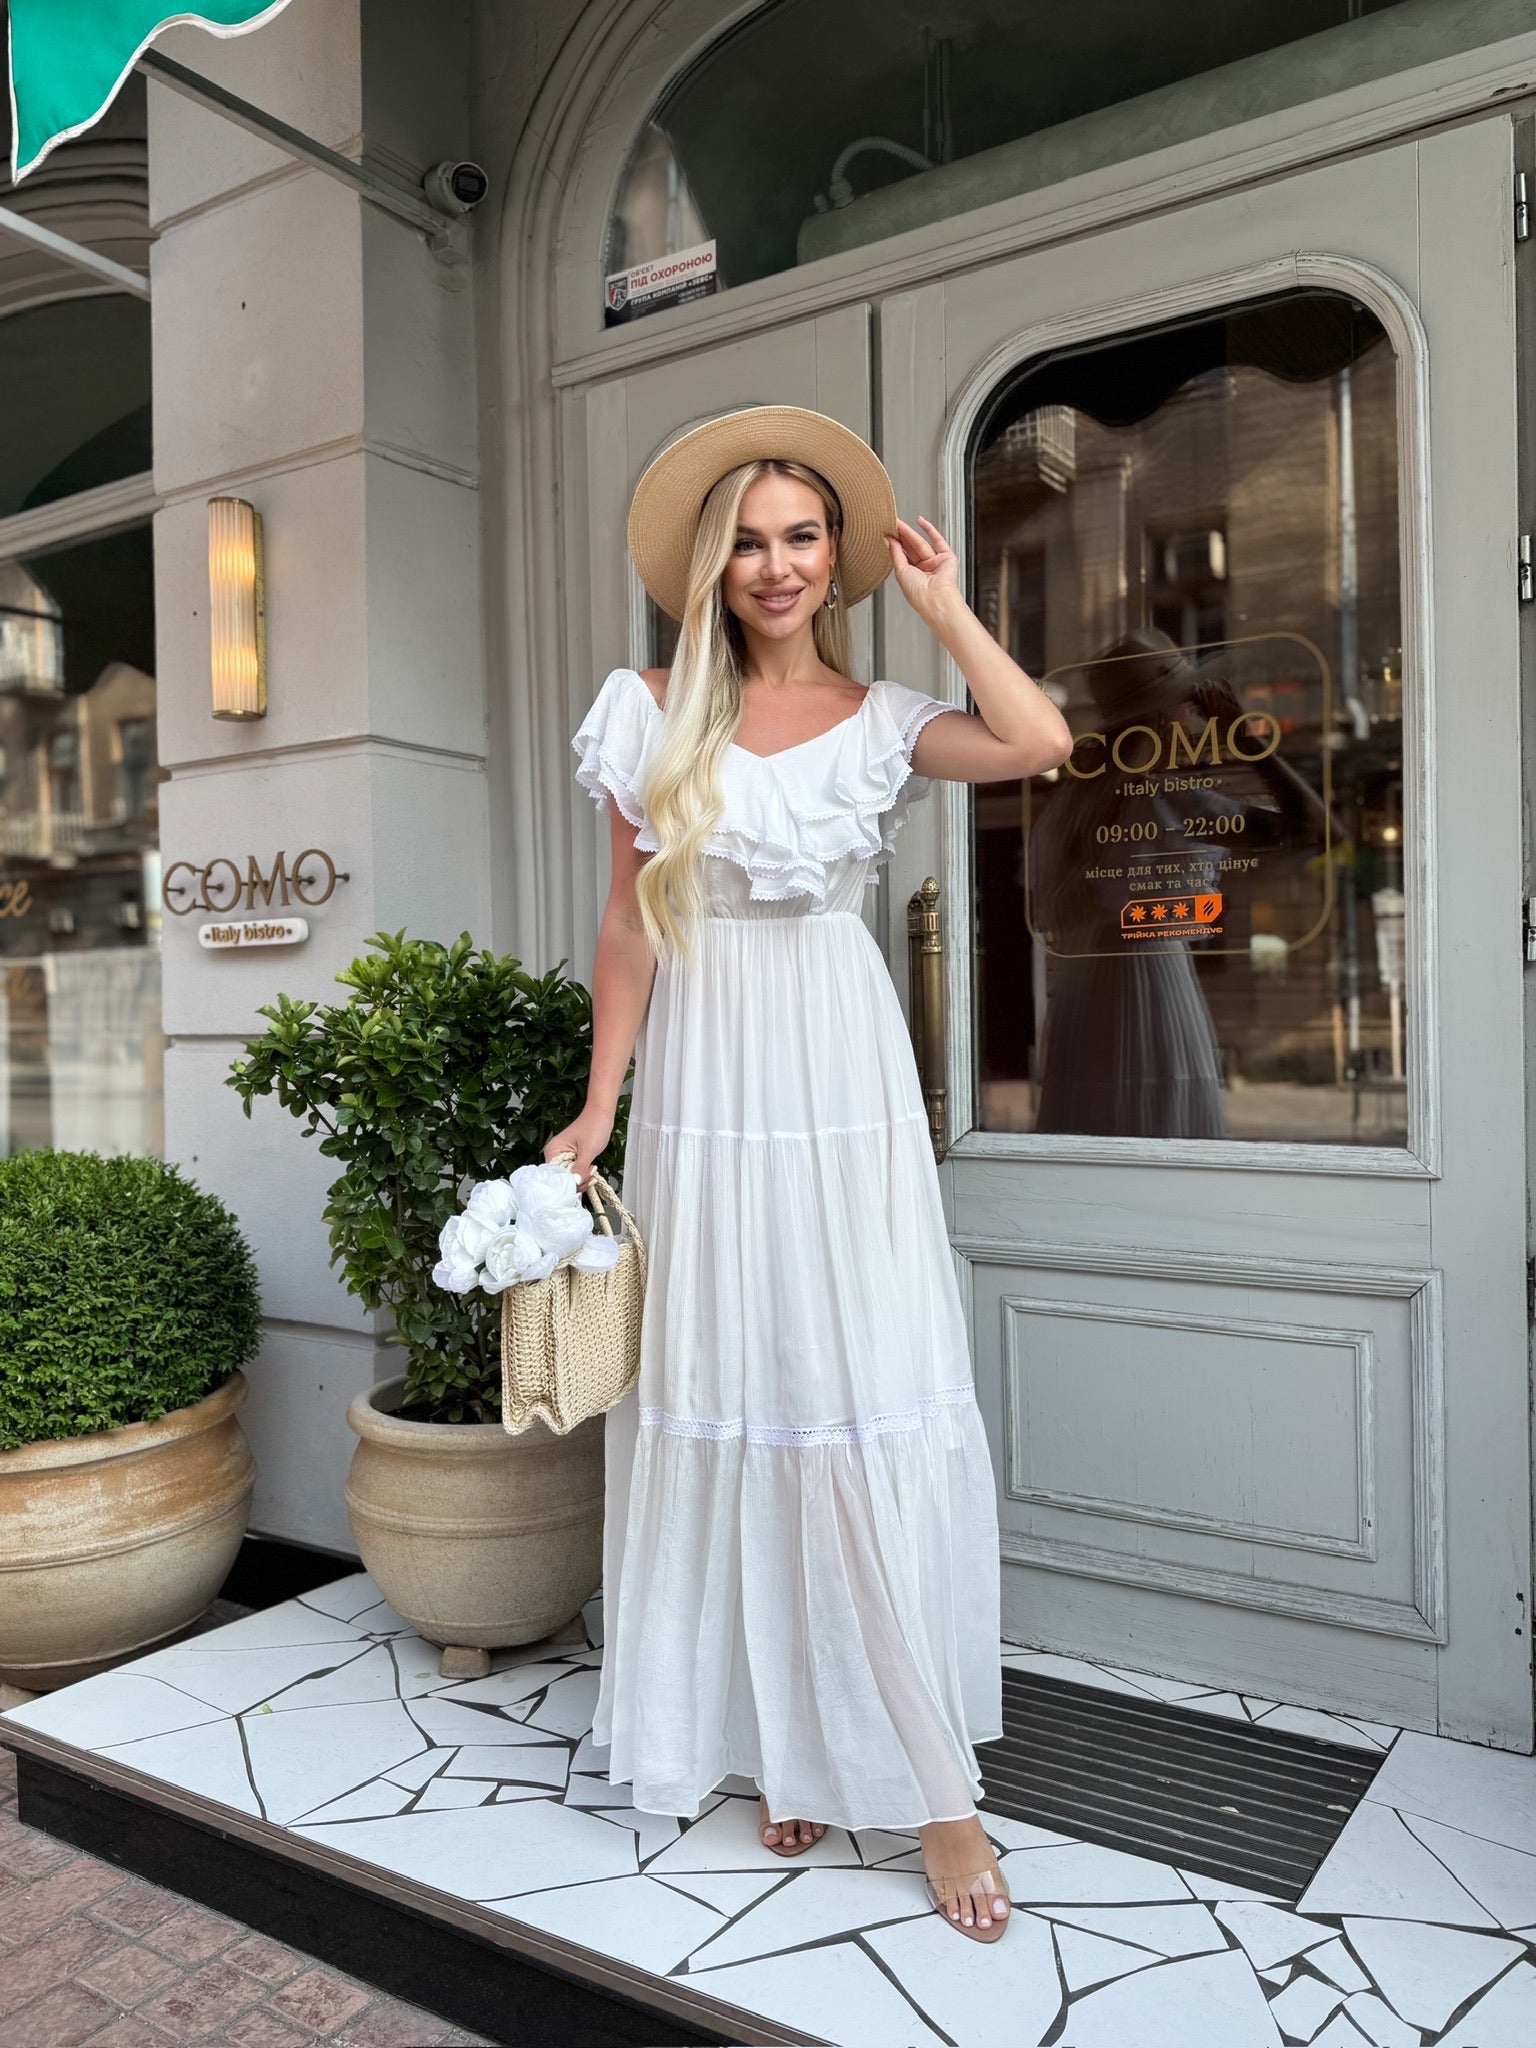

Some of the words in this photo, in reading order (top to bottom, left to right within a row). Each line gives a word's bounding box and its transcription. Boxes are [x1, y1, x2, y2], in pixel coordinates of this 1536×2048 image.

[630, 276, 648, 289] ПІД
[650, 253, 713, 282] ОХОРОНОЮ
[630, 294, 652, 306] ГРУПА
[652, 282, 688, 299] КОМПАНІЙ
[1065, 711, 1281, 779] COMO
[1123, 780, 1159, 797] Italy
[1164, 776, 1214, 793] bistro
[1096, 821, 1158, 844] 09:00
[1183, 814, 1246, 837] 22:00
[1085, 866, 1123, 880] місце
[1127, 864, 1152, 878] для
[1156, 862, 1185, 875] тих,
[1190, 860, 1214, 873] хто
[1219, 857, 1259, 873] цінує
[163, 848, 336, 916] COMO
[1129, 880, 1162, 892] смак
[1166, 879, 1182, 889] та
[1186, 876, 1210, 887] час
[211, 926, 240, 944] Italy
[244, 923, 285, 941] bistro
[1121, 929, 1156, 940] ТРІЙКА
[1157, 926, 1223, 937] РЕКОМЕНДУЄ
